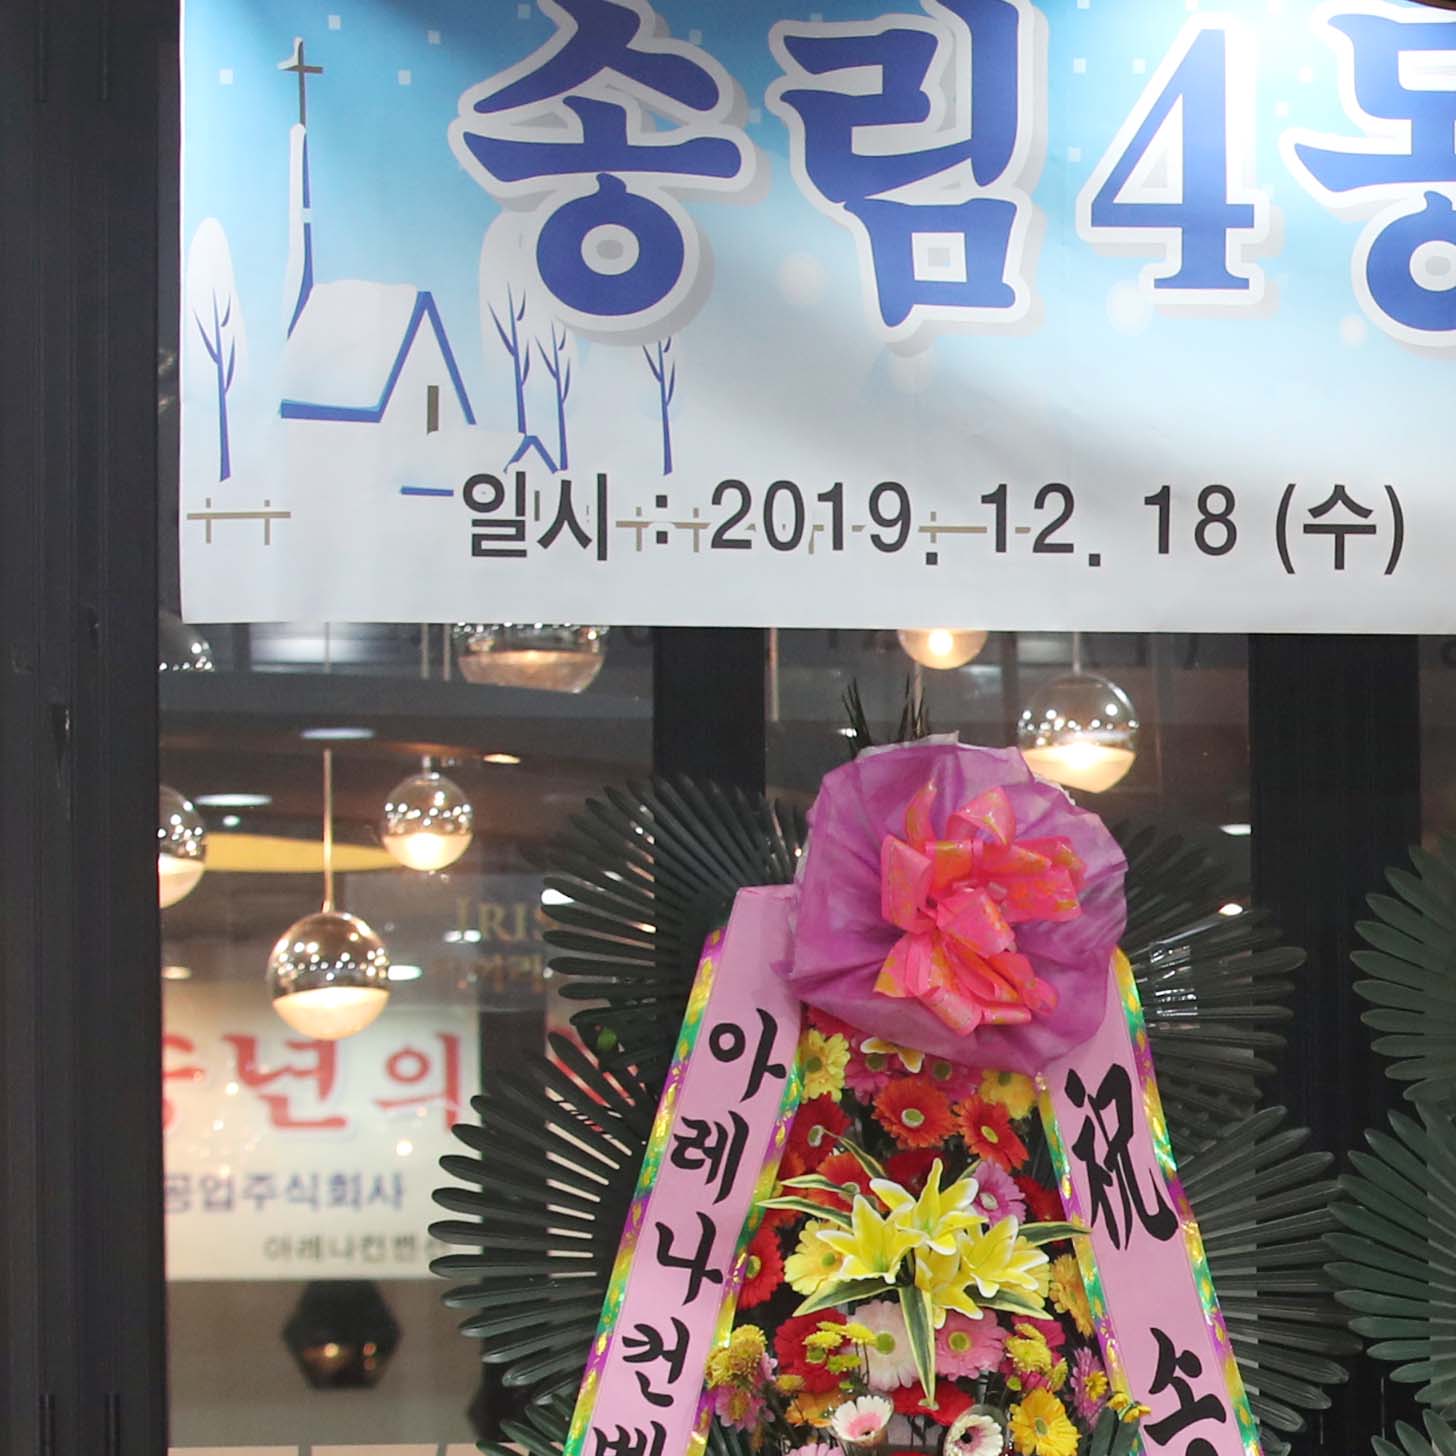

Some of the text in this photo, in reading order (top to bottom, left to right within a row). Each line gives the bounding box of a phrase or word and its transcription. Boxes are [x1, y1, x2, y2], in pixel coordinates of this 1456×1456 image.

[462, 472, 608, 561] 일시
[710, 479, 938, 565] 2019.
[980, 482, 1101, 567] 12.
[1144, 484, 1237, 556] 18
[1275, 483, 1405, 575] (수)
[1071, 1063, 1178, 1250] 祝
